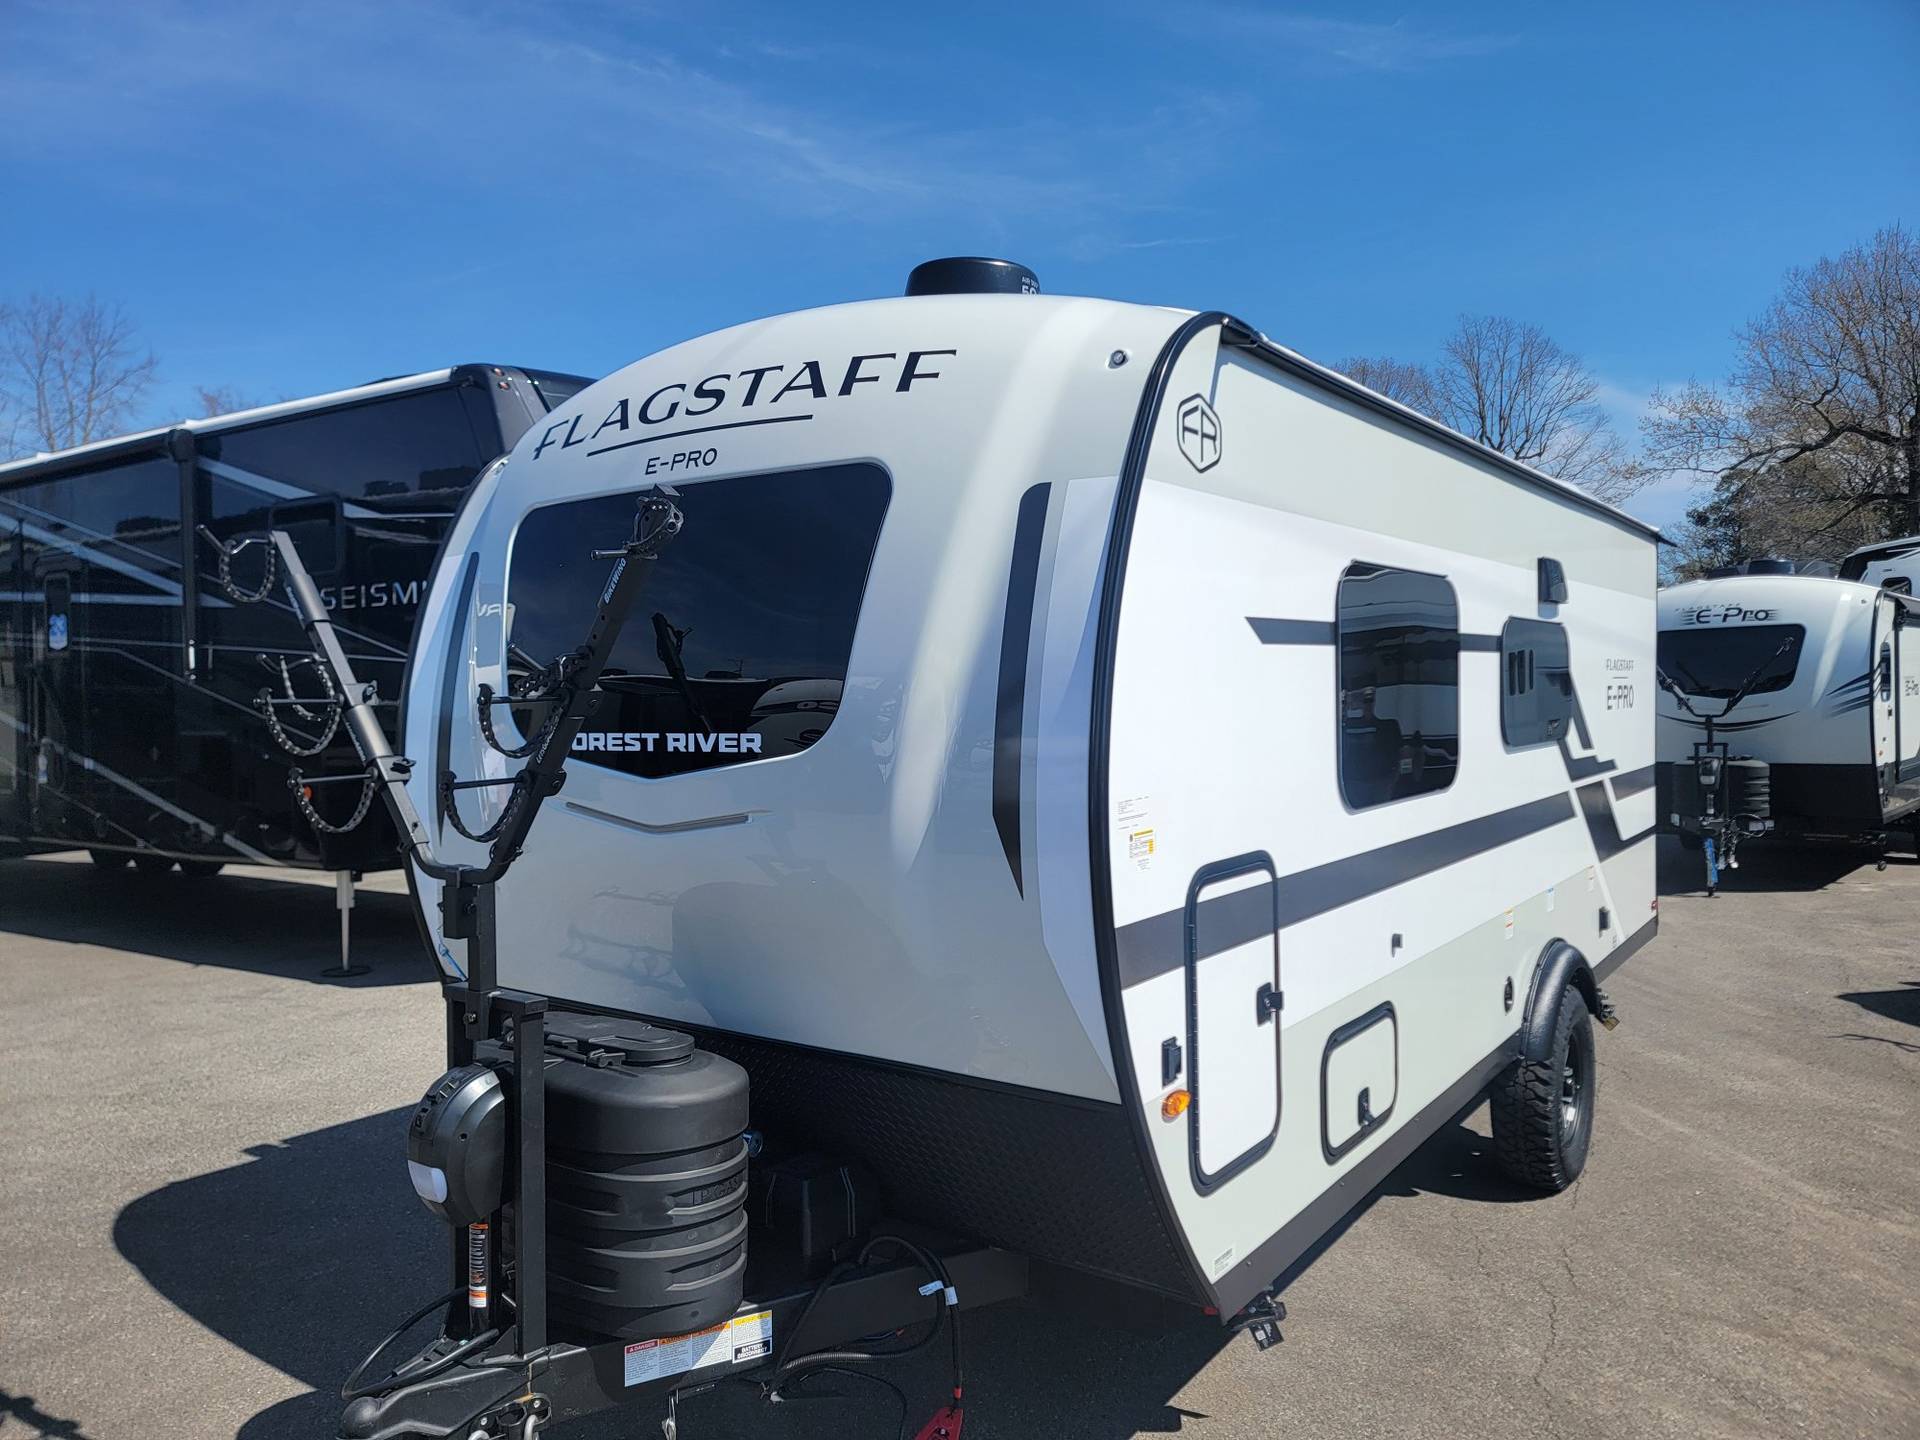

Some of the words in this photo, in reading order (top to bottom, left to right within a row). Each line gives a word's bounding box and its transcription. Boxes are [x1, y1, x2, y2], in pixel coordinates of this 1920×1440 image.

[533, 349, 957, 461] FLAGSTAFF
[645, 447, 718, 475] E-PRO
[1695, 607, 1770, 624] E-Pro
[1607, 684, 1635, 710] E-PRO
[571, 732, 660, 752] OREST
[665, 732, 763, 754] RIVER
